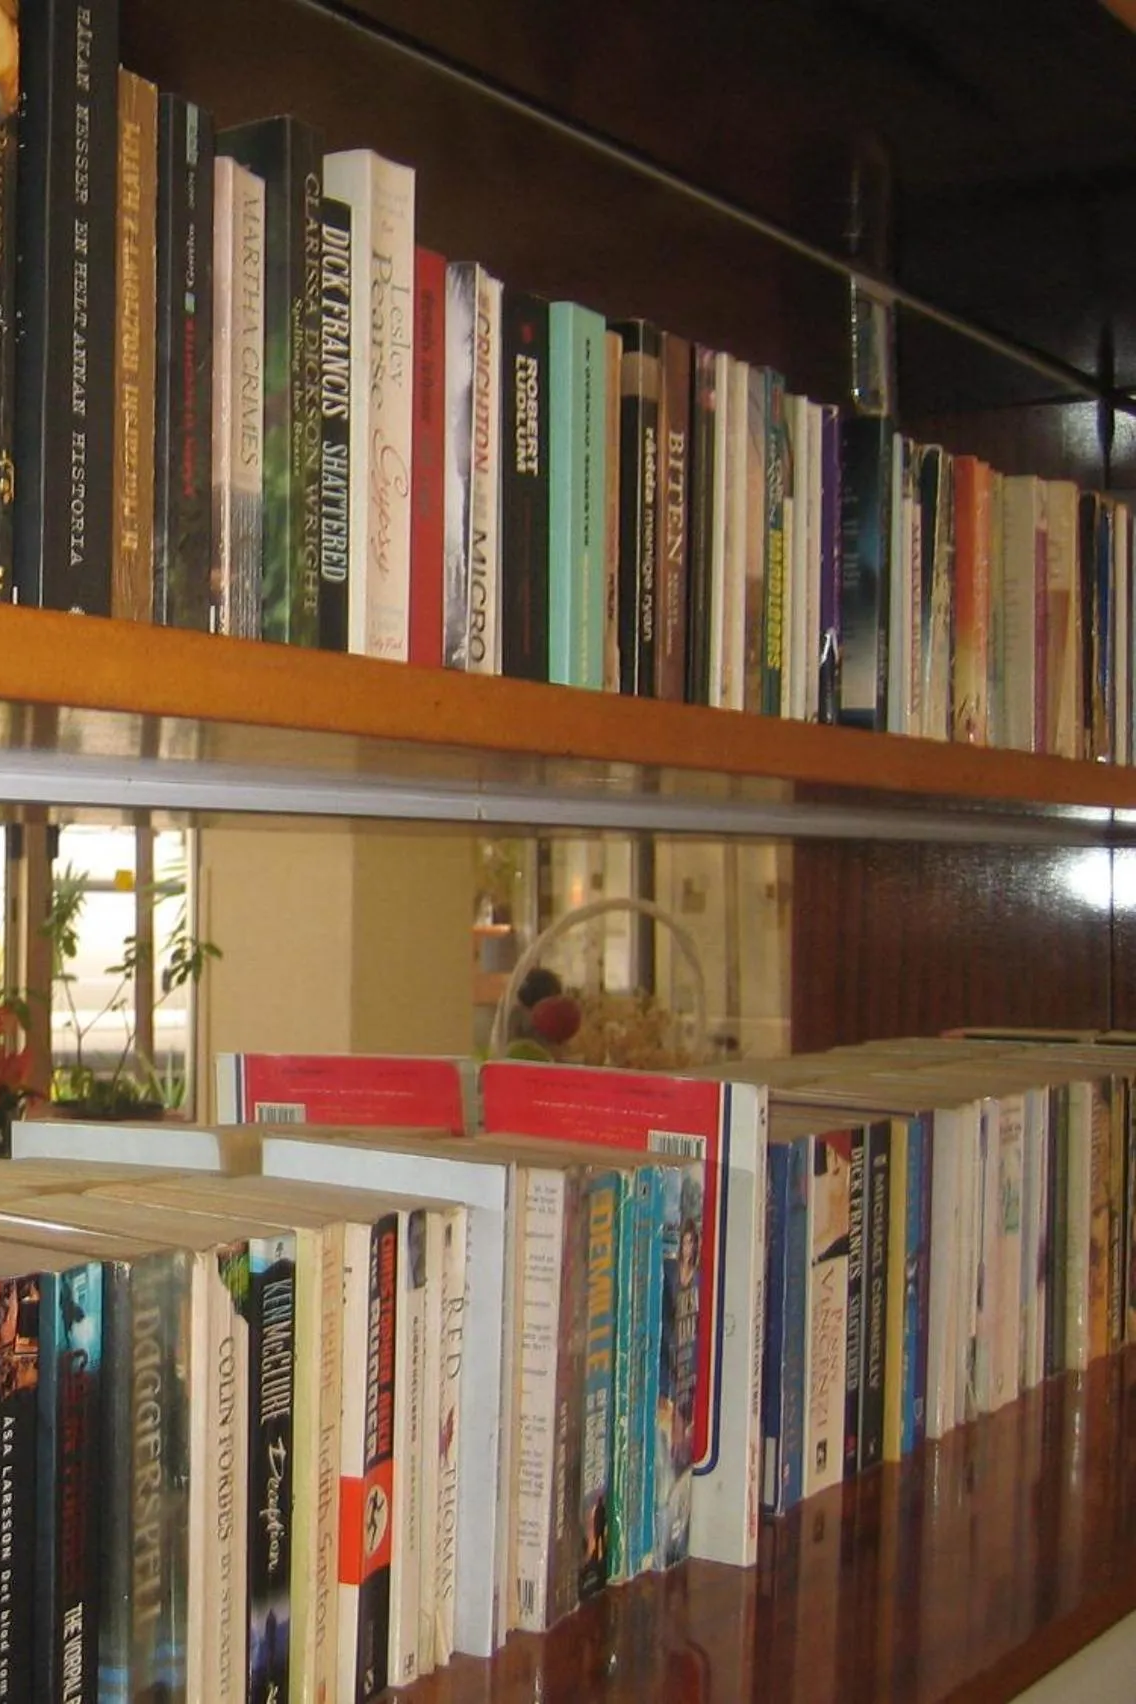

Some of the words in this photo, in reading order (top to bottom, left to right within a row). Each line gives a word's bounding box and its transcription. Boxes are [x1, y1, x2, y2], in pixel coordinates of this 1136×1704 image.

[75, 103, 91, 206] NESSER
[74, 219, 90, 256] EN
[241, 191, 261, 335] MARTHA
[304, 171, 321, 317] CLARISSA
[320, 224, 351, 297] DICK
[73, 261, 90, 326] HELT
[370, 250, 394, 410] Pearse
[389, 283, 412, 388] Lesley
[71, 331, 89, 417] ANNAN
[240, 345, 261, 467] GRIMES
[304, 321, 321, 466] DICKSON
[320, 299, 352, 421] FRANCIS
[473, 307, 493, 475] CRICHTON
[515, 353, 528, 474] LUDLUM
[525, 356, 540, 478] ROBERT
[70, 432, 88, 567] HISTORIA
[303, 484, 321, 617] WRIGHT
[320, 440, 350, 584] SHATTERED
[369, 428, 410, 580] Gypsy
[667, 432, 686, 566] BITEN
[469, 529, 489, 663] MICRO
[641, 596, 655, 643] ryan
[851, 1144, 865, 1190] DICK
[848, 1193, 864, 1282] FRANCIS
[871, 1170, 886, 1274] MICHAEL
[261, 1278, 294, 1329] KEN
[444, 1297, 465, 1381] RED
[845, 1290, 860, 1393] SHATTERED
[868, 1277, 883, 1391] CONNELLY
[216, 1336, 236, 1428] COLIN
[260, 1319, 293, 1429] McCLURE
[364, 1297, 382, 1466] RUNNER
[0, 1415, 18, 1457] ÅSA
[214, 1434, 235, 1543] FORBES
[317, 1422, 338, 1521] Judith
[0, 1464, 16, 1559] LARSSON
[440, 1465, 458, 1602] THOMAS
[0, 1569, 14, 1605] Det
[63, 1602, 84, 1641] THE
[62, 1634, 84, 1702] VORPAL
